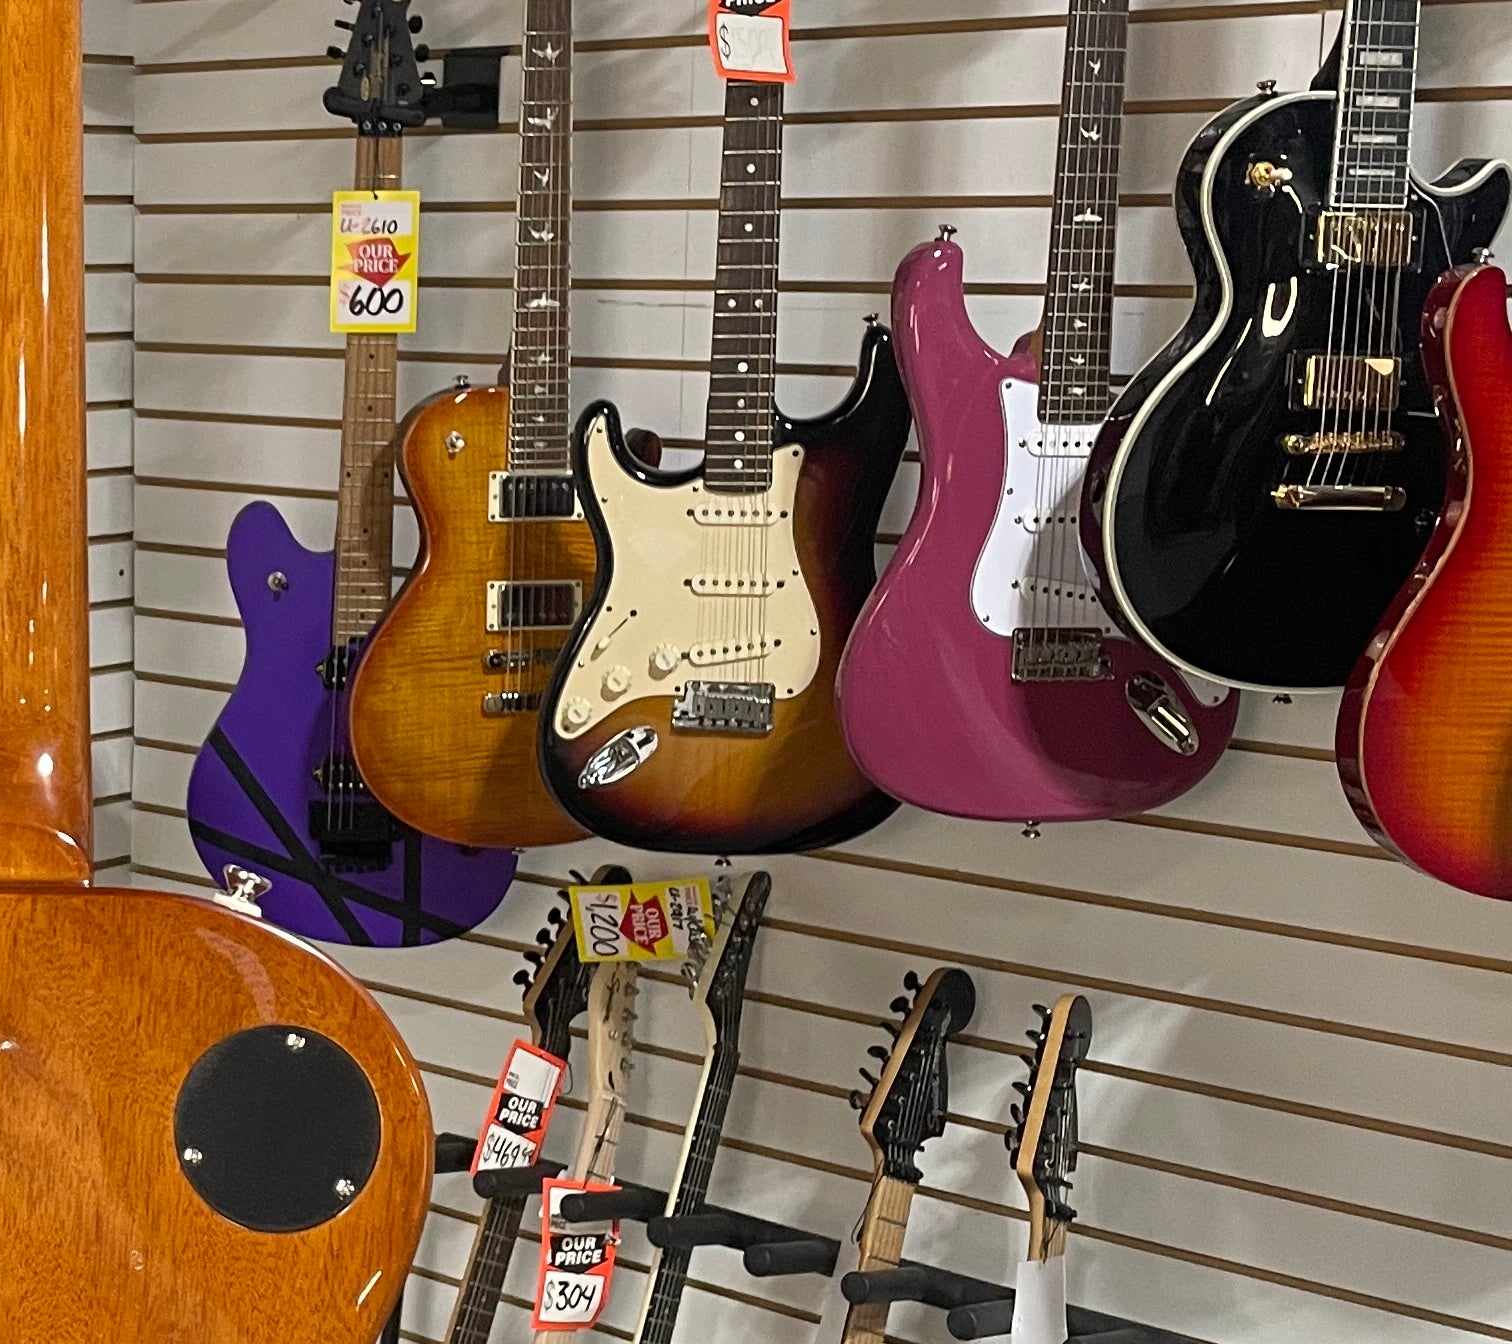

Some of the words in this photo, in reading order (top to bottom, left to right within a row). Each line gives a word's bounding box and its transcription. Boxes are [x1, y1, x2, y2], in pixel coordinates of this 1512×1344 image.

[358, 244, 393, 259] OUR
[353, 258, 399, 274] PRICE
[629, 904, 649, 945] PRICE
[645, 907, 662, 939] OUR
[508, 1096, 537, 1114] OUR
[498, 1107, 540, 1129] PRICE
[561, 1236, 597, 1252] OUR
[554, 1248, 603, 1266] PRICE
